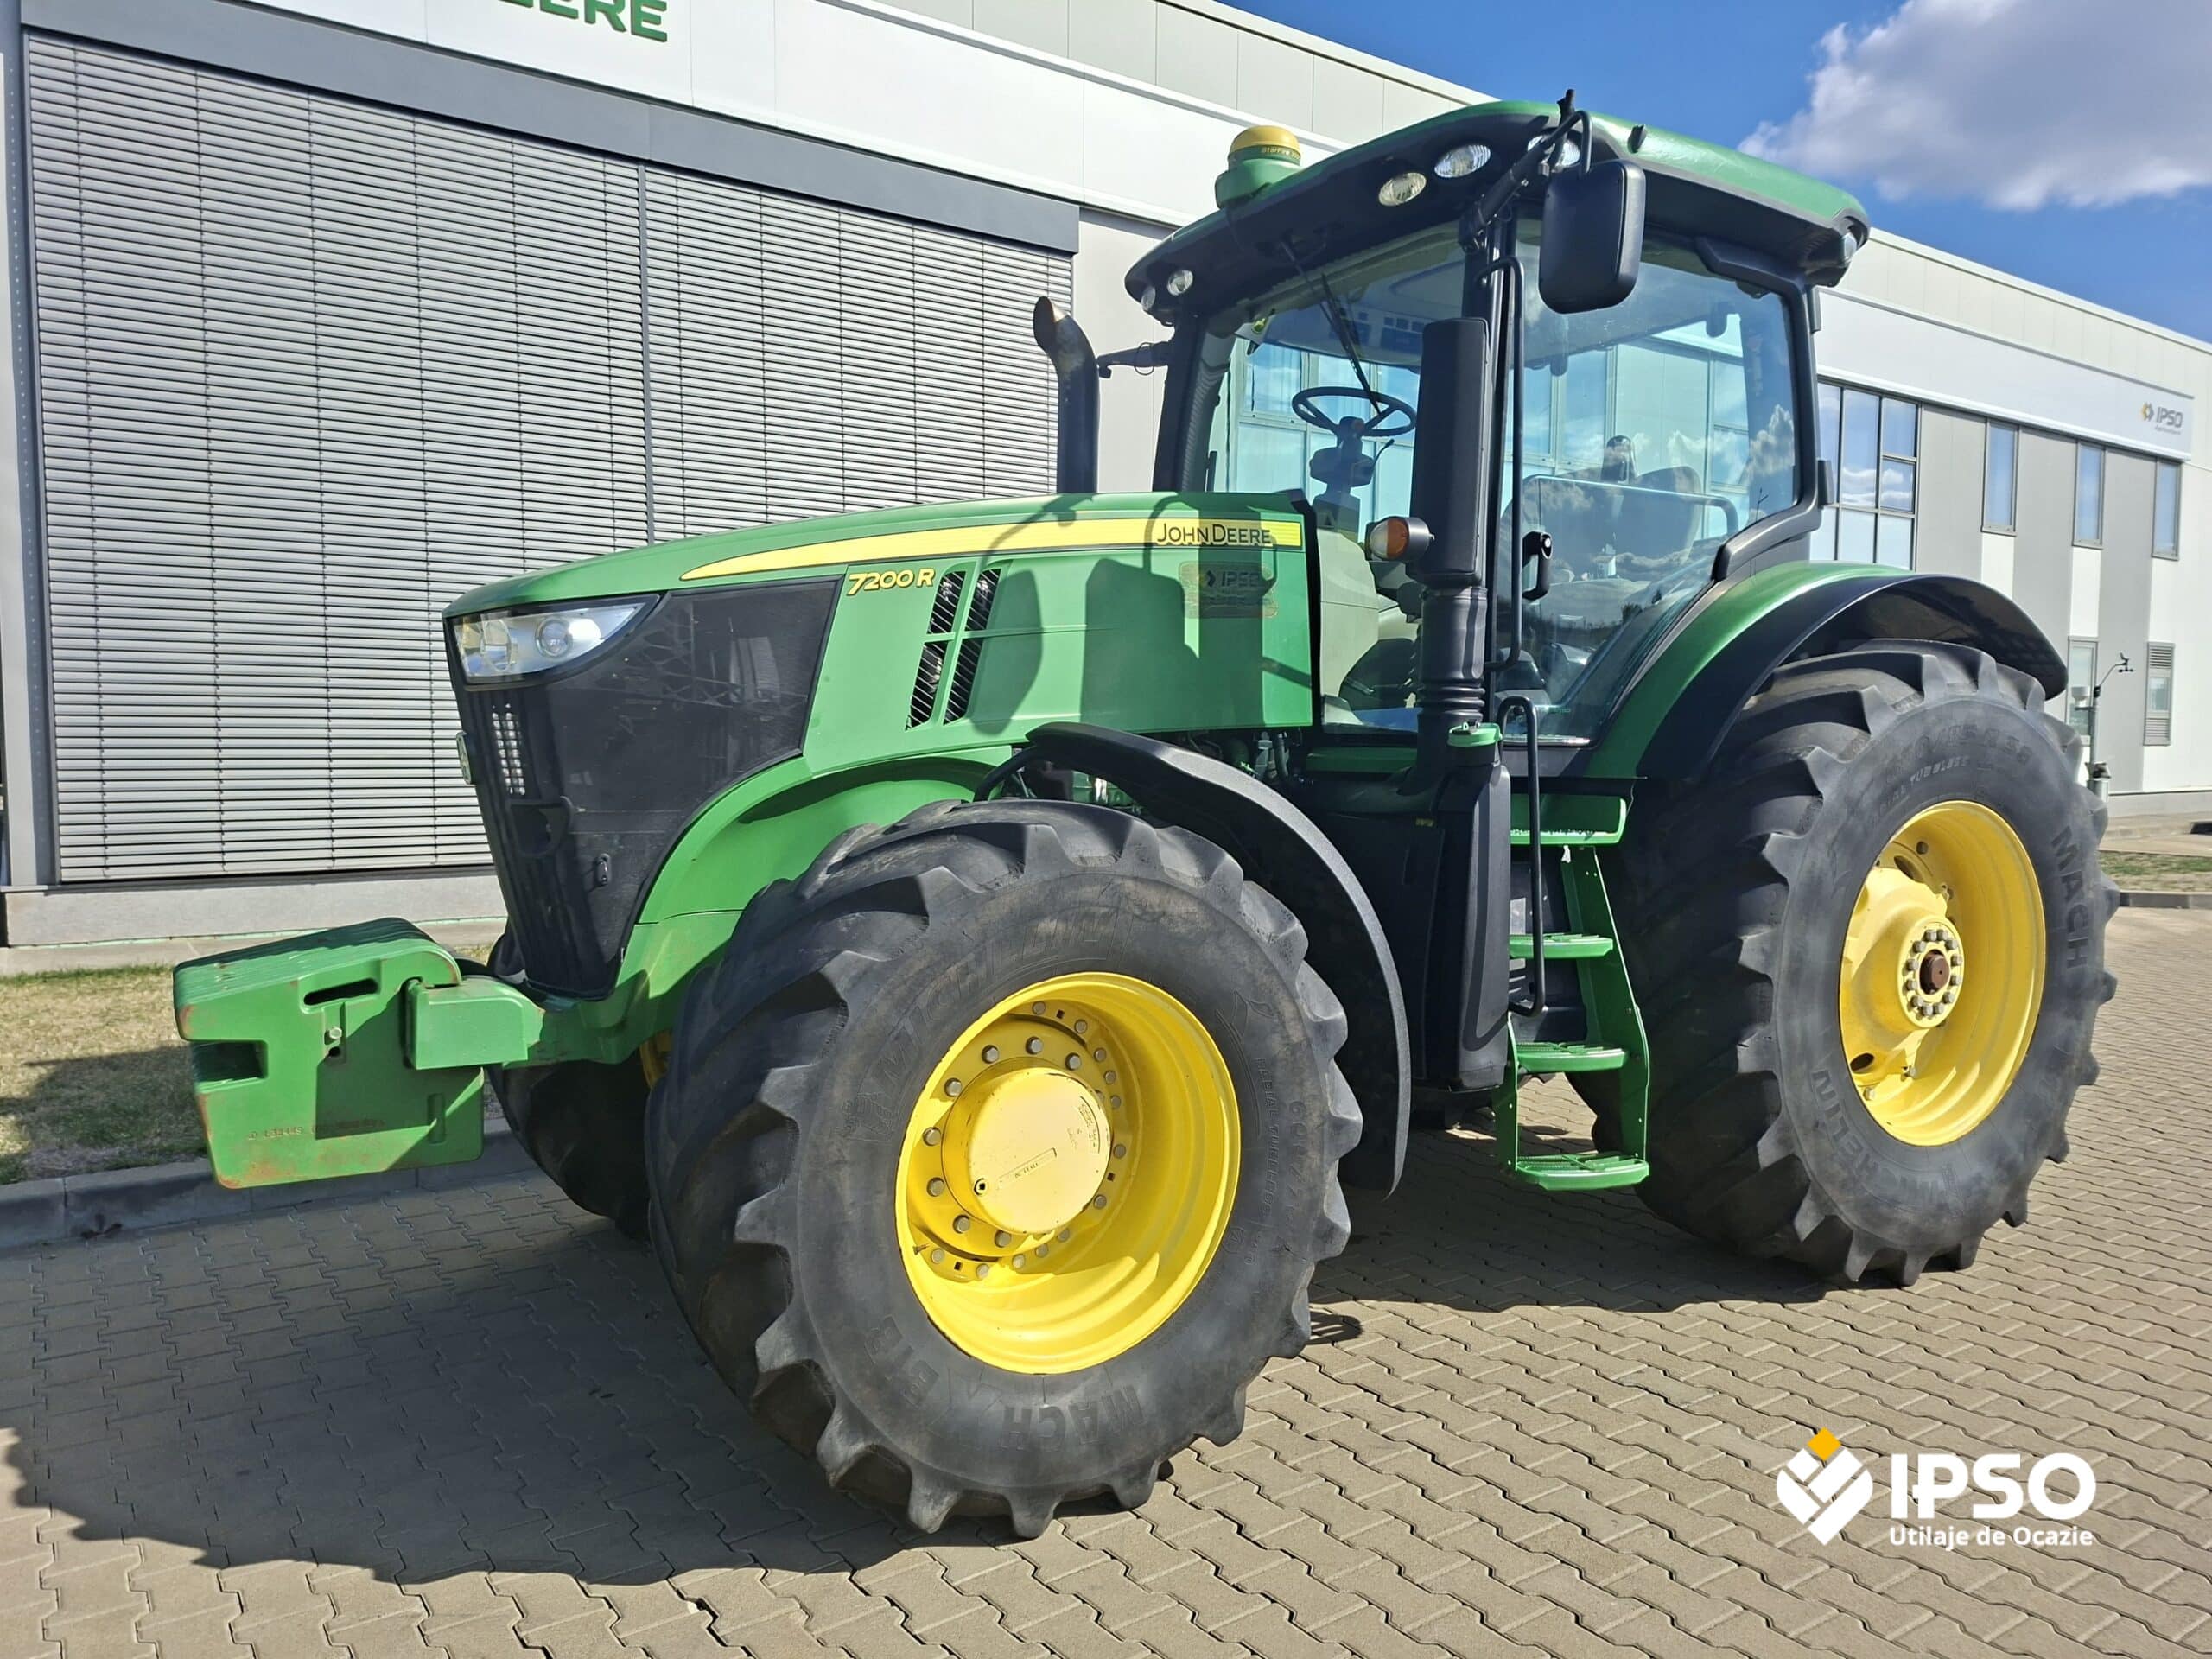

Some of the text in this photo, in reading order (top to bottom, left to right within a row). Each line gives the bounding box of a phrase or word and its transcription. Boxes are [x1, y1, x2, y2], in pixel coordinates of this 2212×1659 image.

[498, 0, 668, 42] RE
[2156, 406, 2183, 429] IPSO
[2051, 825, 2088, 969] MACH
[996, 1384, 1146, 1452] MACH
